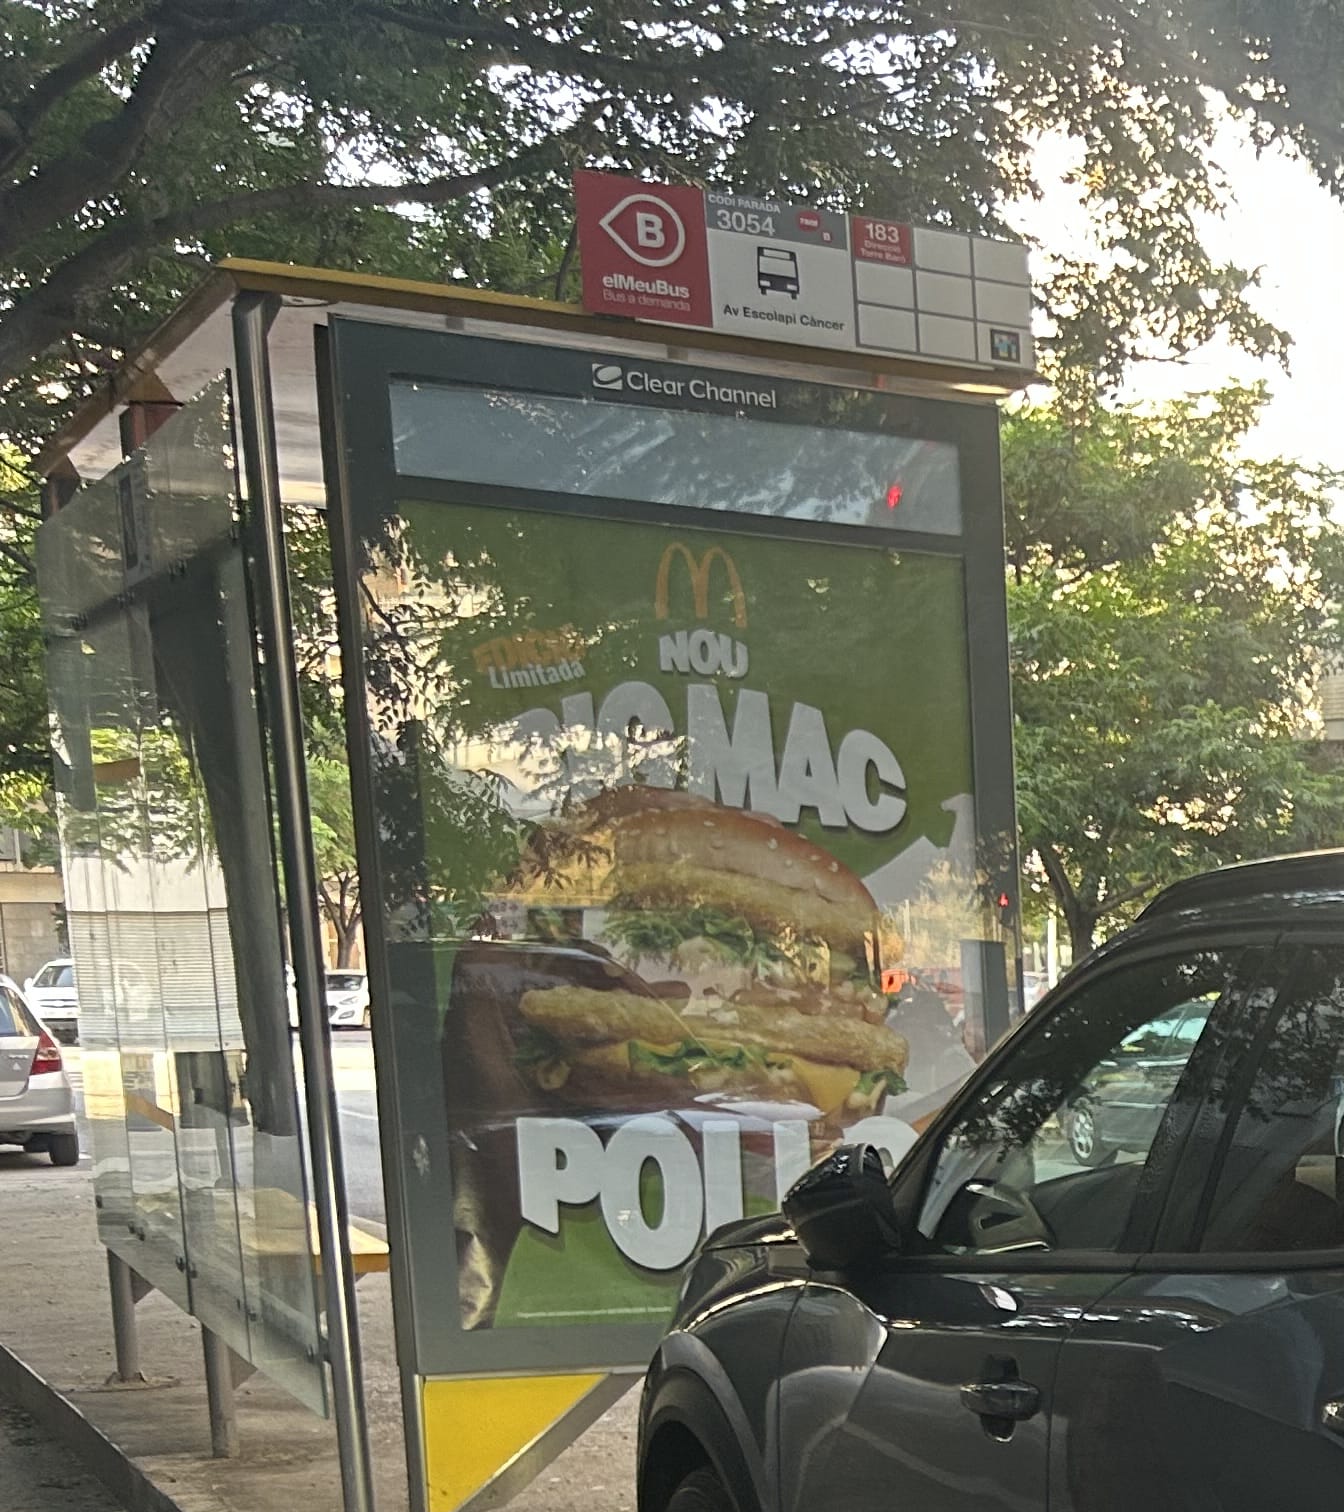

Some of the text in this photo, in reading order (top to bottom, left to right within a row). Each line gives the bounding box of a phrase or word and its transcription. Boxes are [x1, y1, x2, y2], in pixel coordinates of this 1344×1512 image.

[708, 193, 780, 213] CODI PARADA
[636, 212, 665, 248] B
[717, 209, 775, 236] 3054
[865, 223, 899, 243] 183
[602, 273, 690, 299] elMeuBus
[602, 288, 691, 312] Bus a demanda
[723, 304, 845, 331] Av Escolapi Càncer
[626, 371, 776, 409] Clear Channel
[658, 629, 748, 679] NOU
[487, 656, 586, 689] Limitada
[687, 682, 907, 833] MAC
